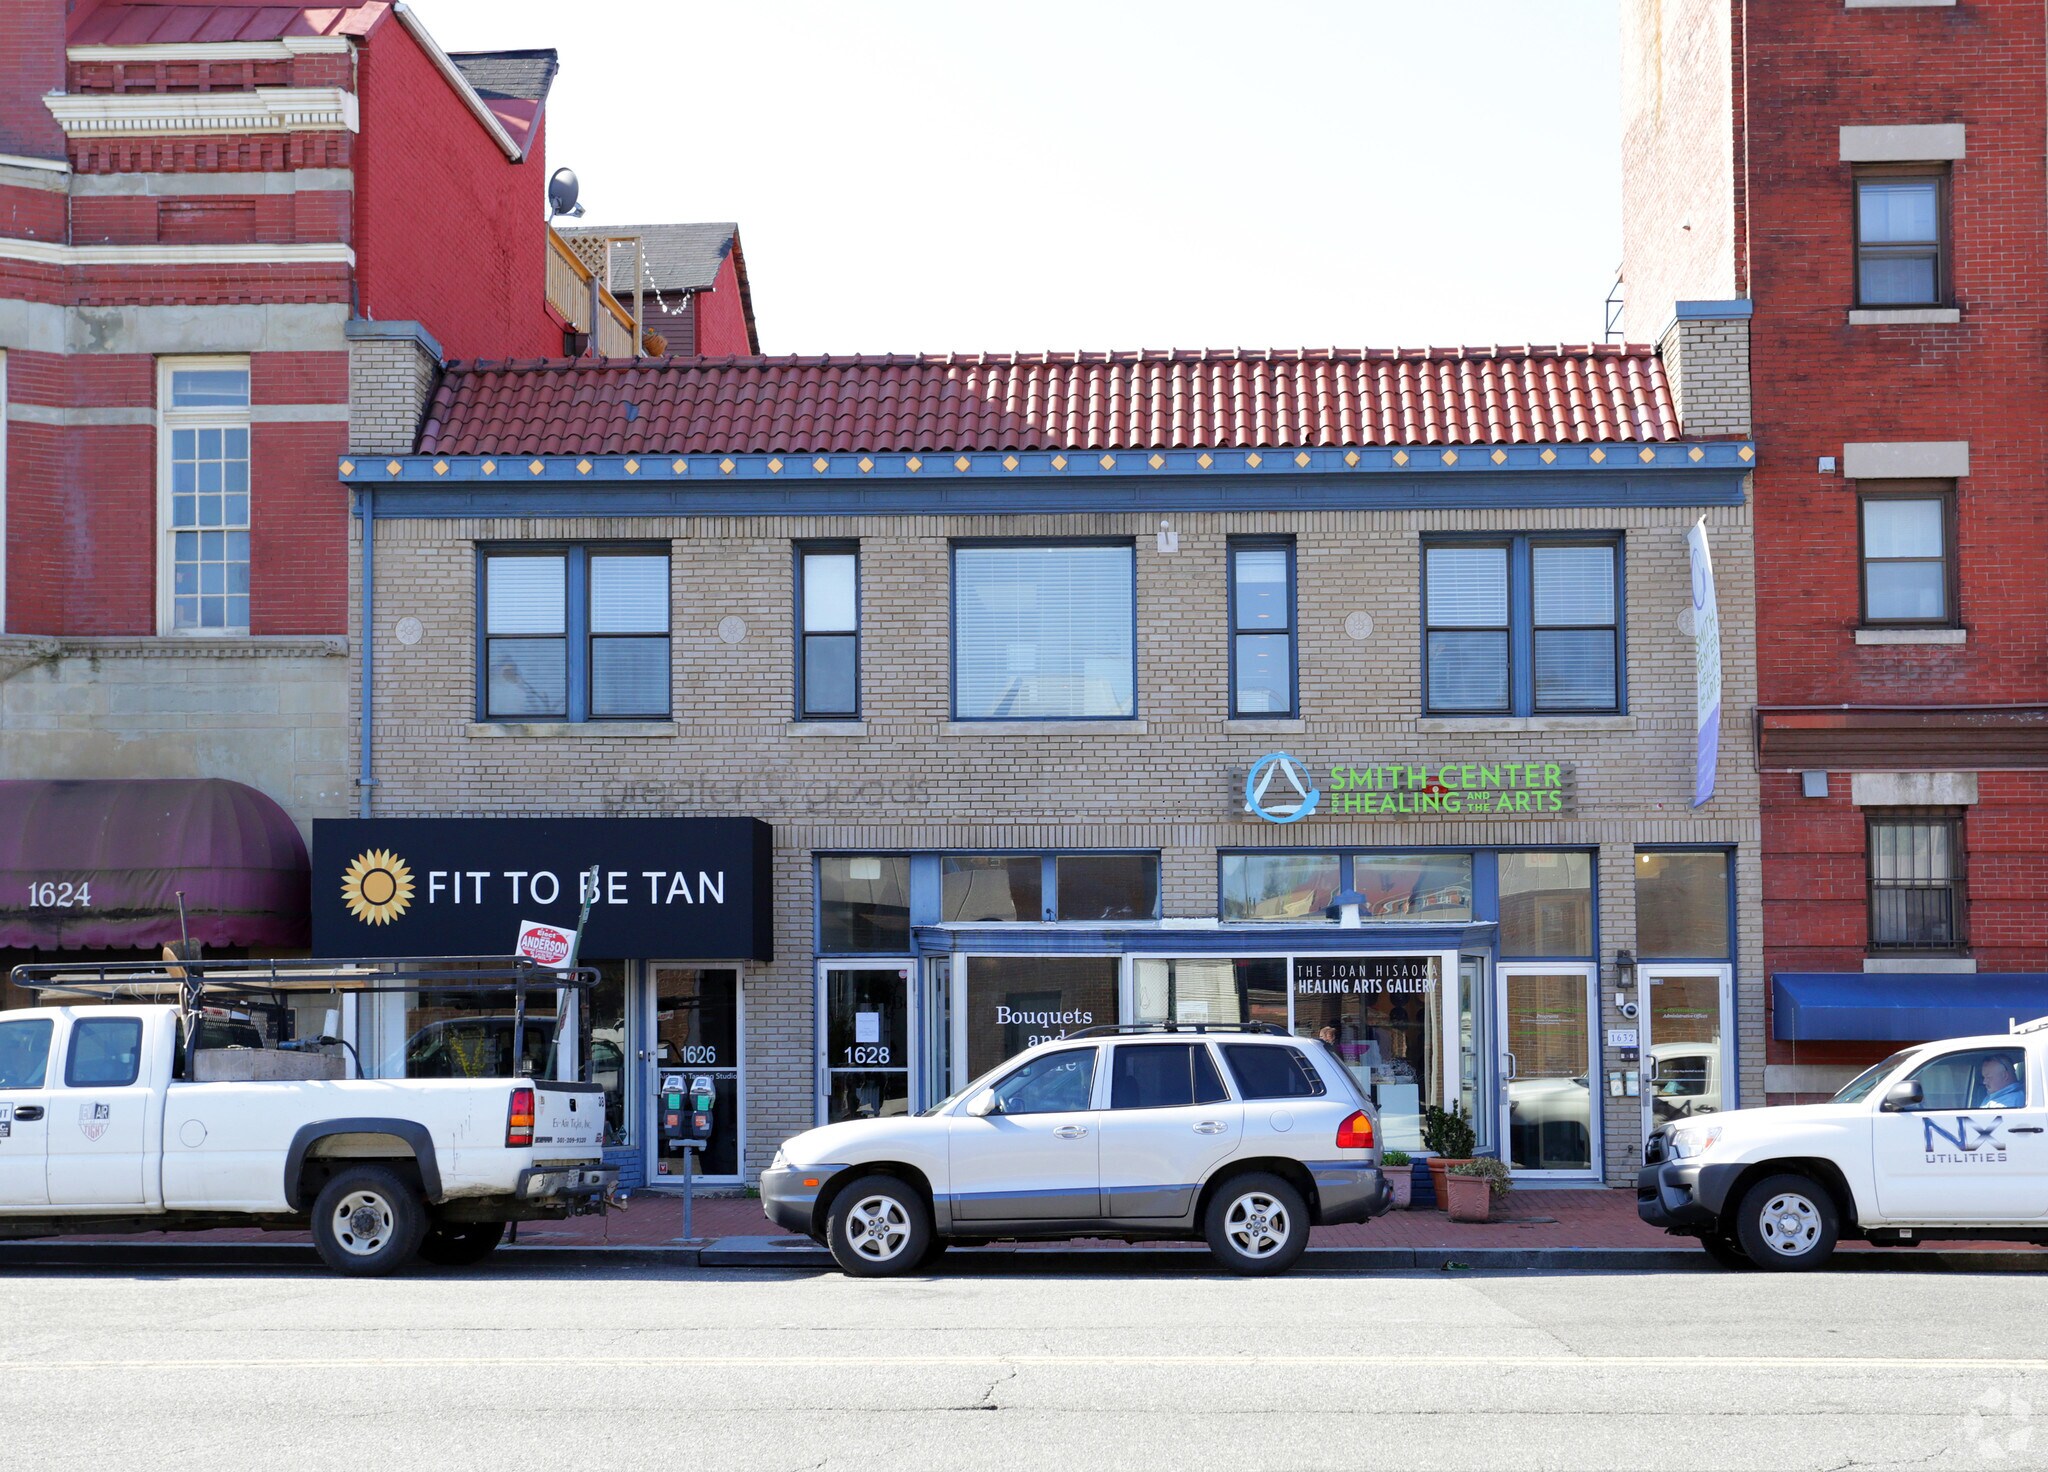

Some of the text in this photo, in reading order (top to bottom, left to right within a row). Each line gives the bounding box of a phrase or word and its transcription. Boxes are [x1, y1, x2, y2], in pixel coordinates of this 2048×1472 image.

[1330, 764, 1562, 790] SMITH CENTER
[1344, 791, 1461, 813] HEALING
[1466, 791, 1490, 800] AND
[1496, 789, 1562, 812] ARTS
[1467, 803, 1490, 812] THE
[28, 881, 92, 908] 1624
[429, 870, 724, 905] FIT TO BE TAN
[536, 929, 557, 939] Elect
[521, 935, 568, 955] ANDERSON
[1297, 964, 1438, 978] THE JOAN HISAOKA
[1299, 979, 1438, 994] HEALING ARTS GALLERY
[995, 1006, 1093, 1029] Bouquets
[1611, 1033, 1634, 1042] 1632
[681, 1045, 716, 1064] 1626
[844, 1046, 890, 1064] 1628
[716, 1072, 738, 1080] Studio
[1922, 1115, 2006, 1152] NX
[1926, 1152, 2008, 1164] UTILITIES
